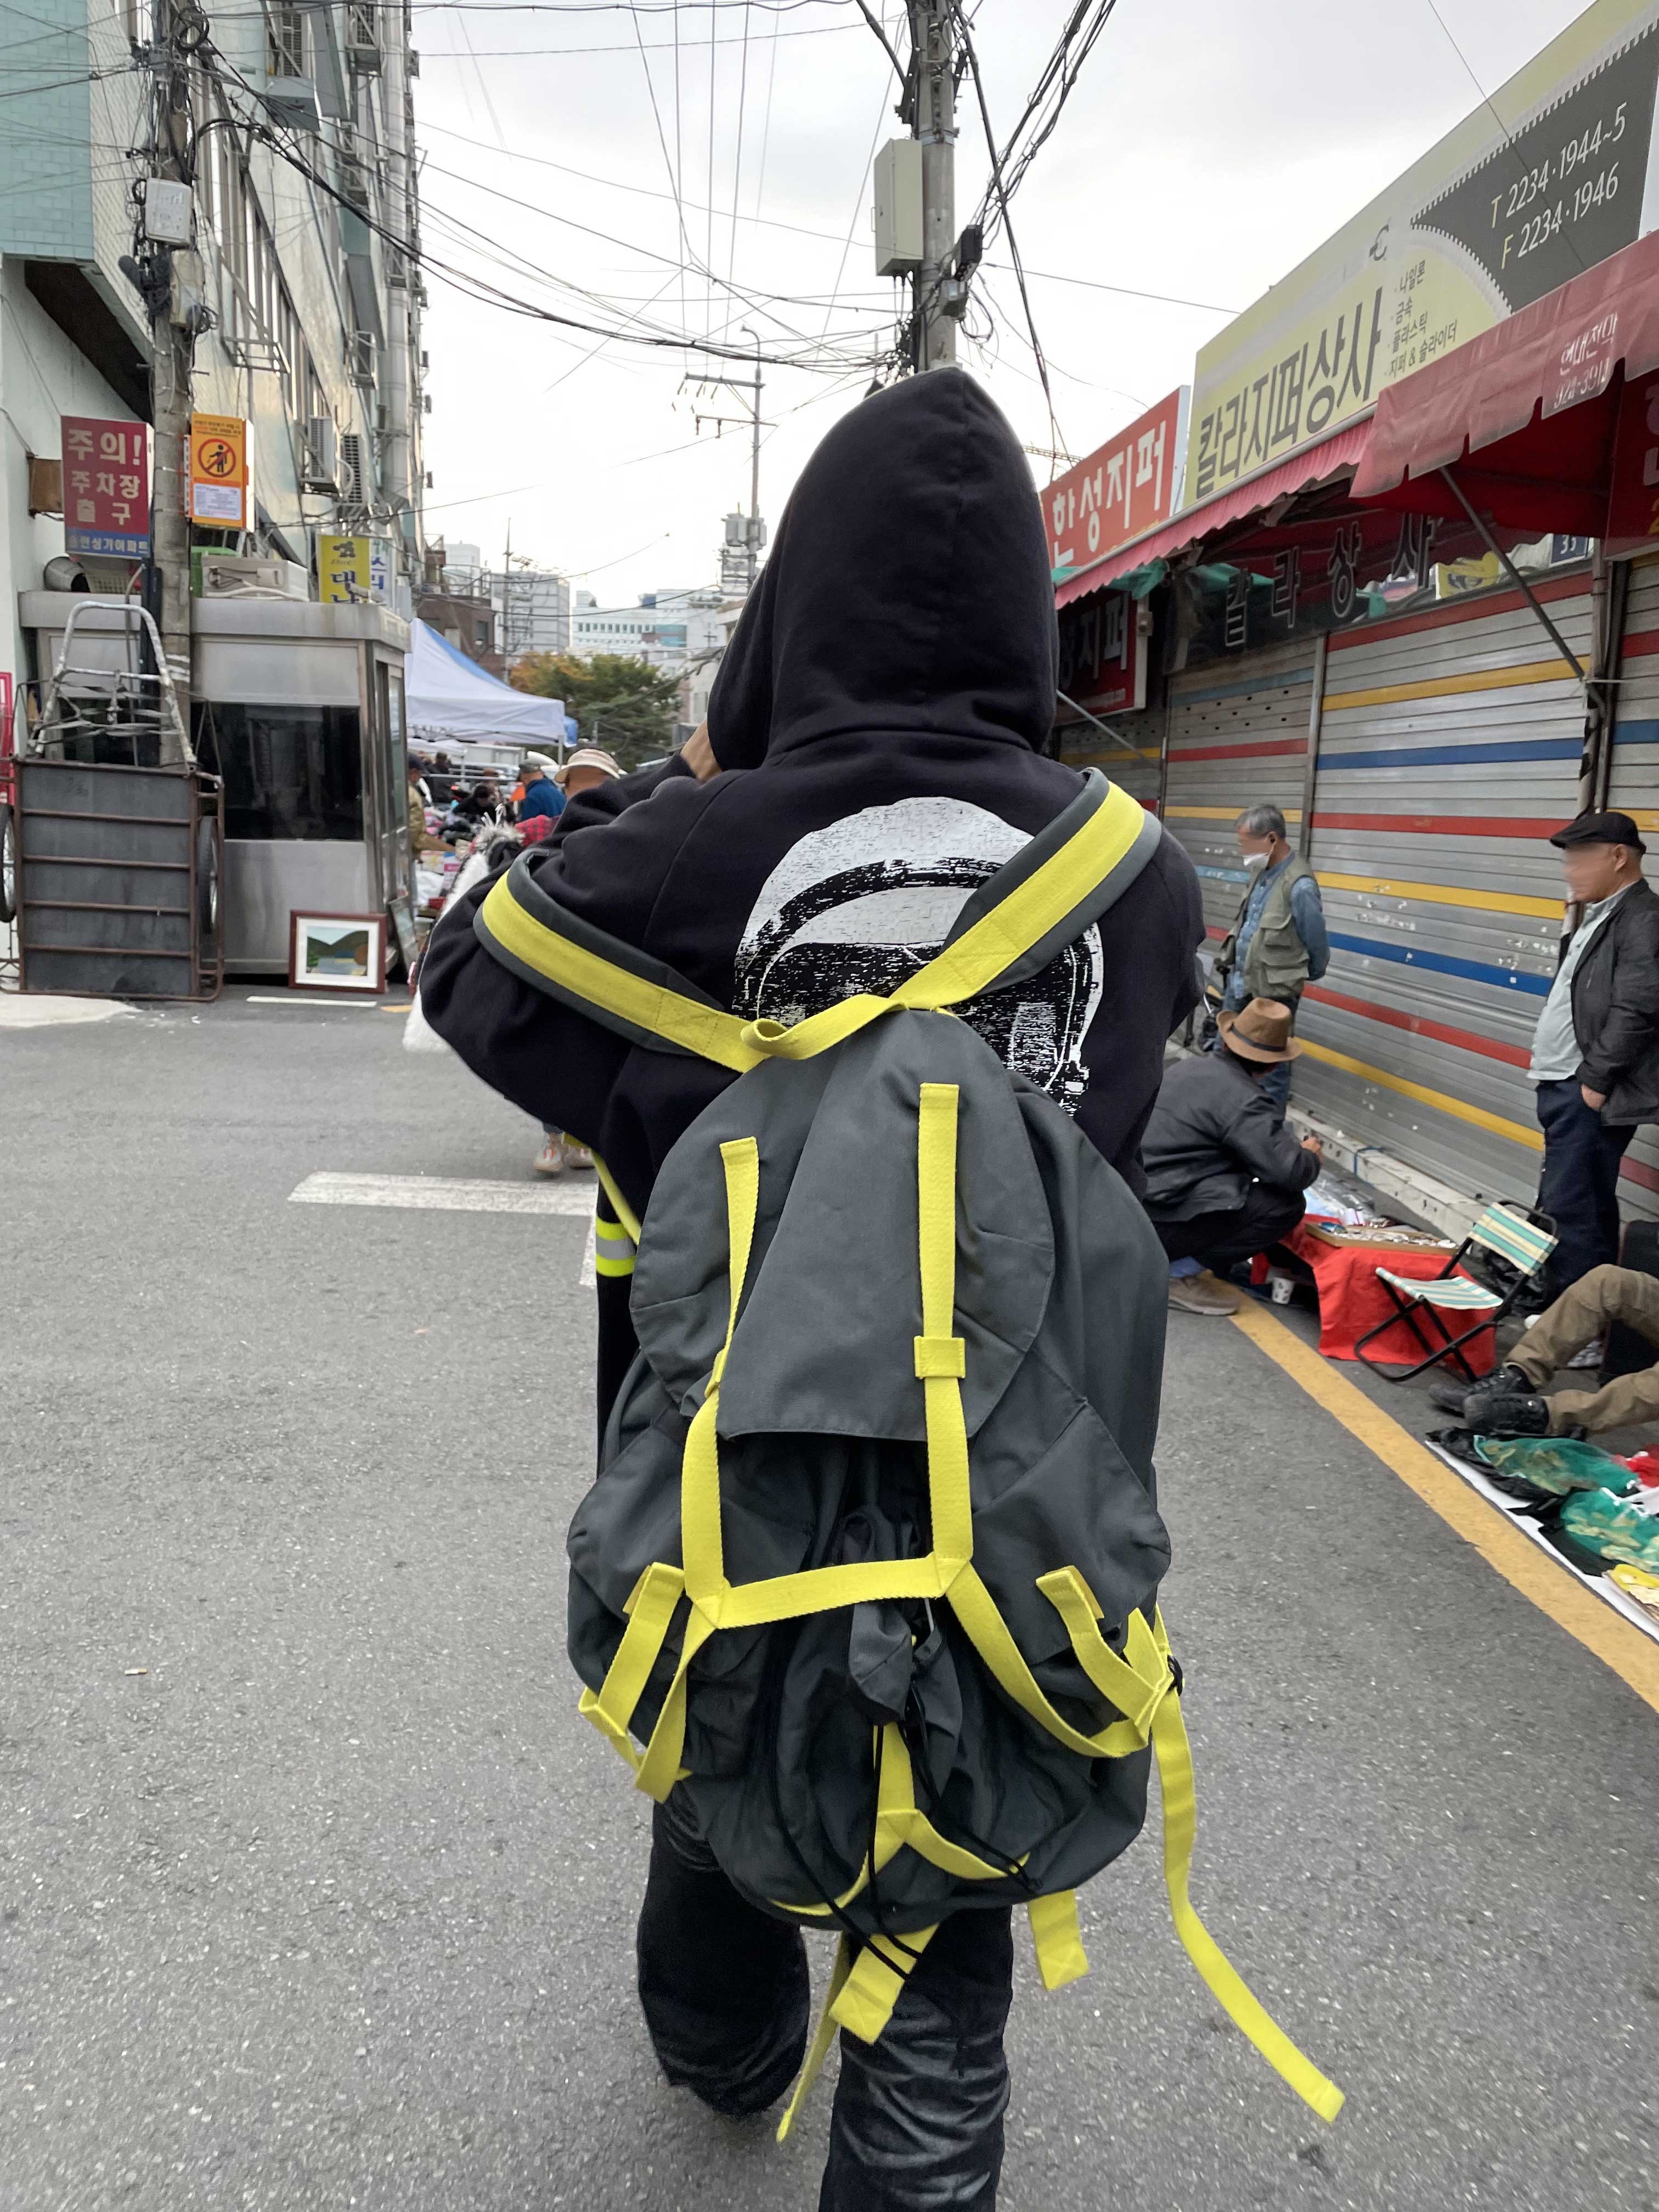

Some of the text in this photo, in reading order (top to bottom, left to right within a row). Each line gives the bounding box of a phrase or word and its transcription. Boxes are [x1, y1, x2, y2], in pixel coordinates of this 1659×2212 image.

[1492, 195, 1502, 228] T
[1502, 234, 1514, 269] F
[1400, 259, 1425, 294] 나일론
[1396, 296, 1413, 326] 금속
[1390, 319, 1457, 379] 지퍼 & 슬라이더
[1393, 311, 1428, 354] 플라스틱
[1196, 286, 1383, 500] 칼라지퍼상사
[67, 428, 142, 466] 주의!
[71, 470, 141, 500] 주차장
[1052, 420, 1166, 571] 한성지퍼
